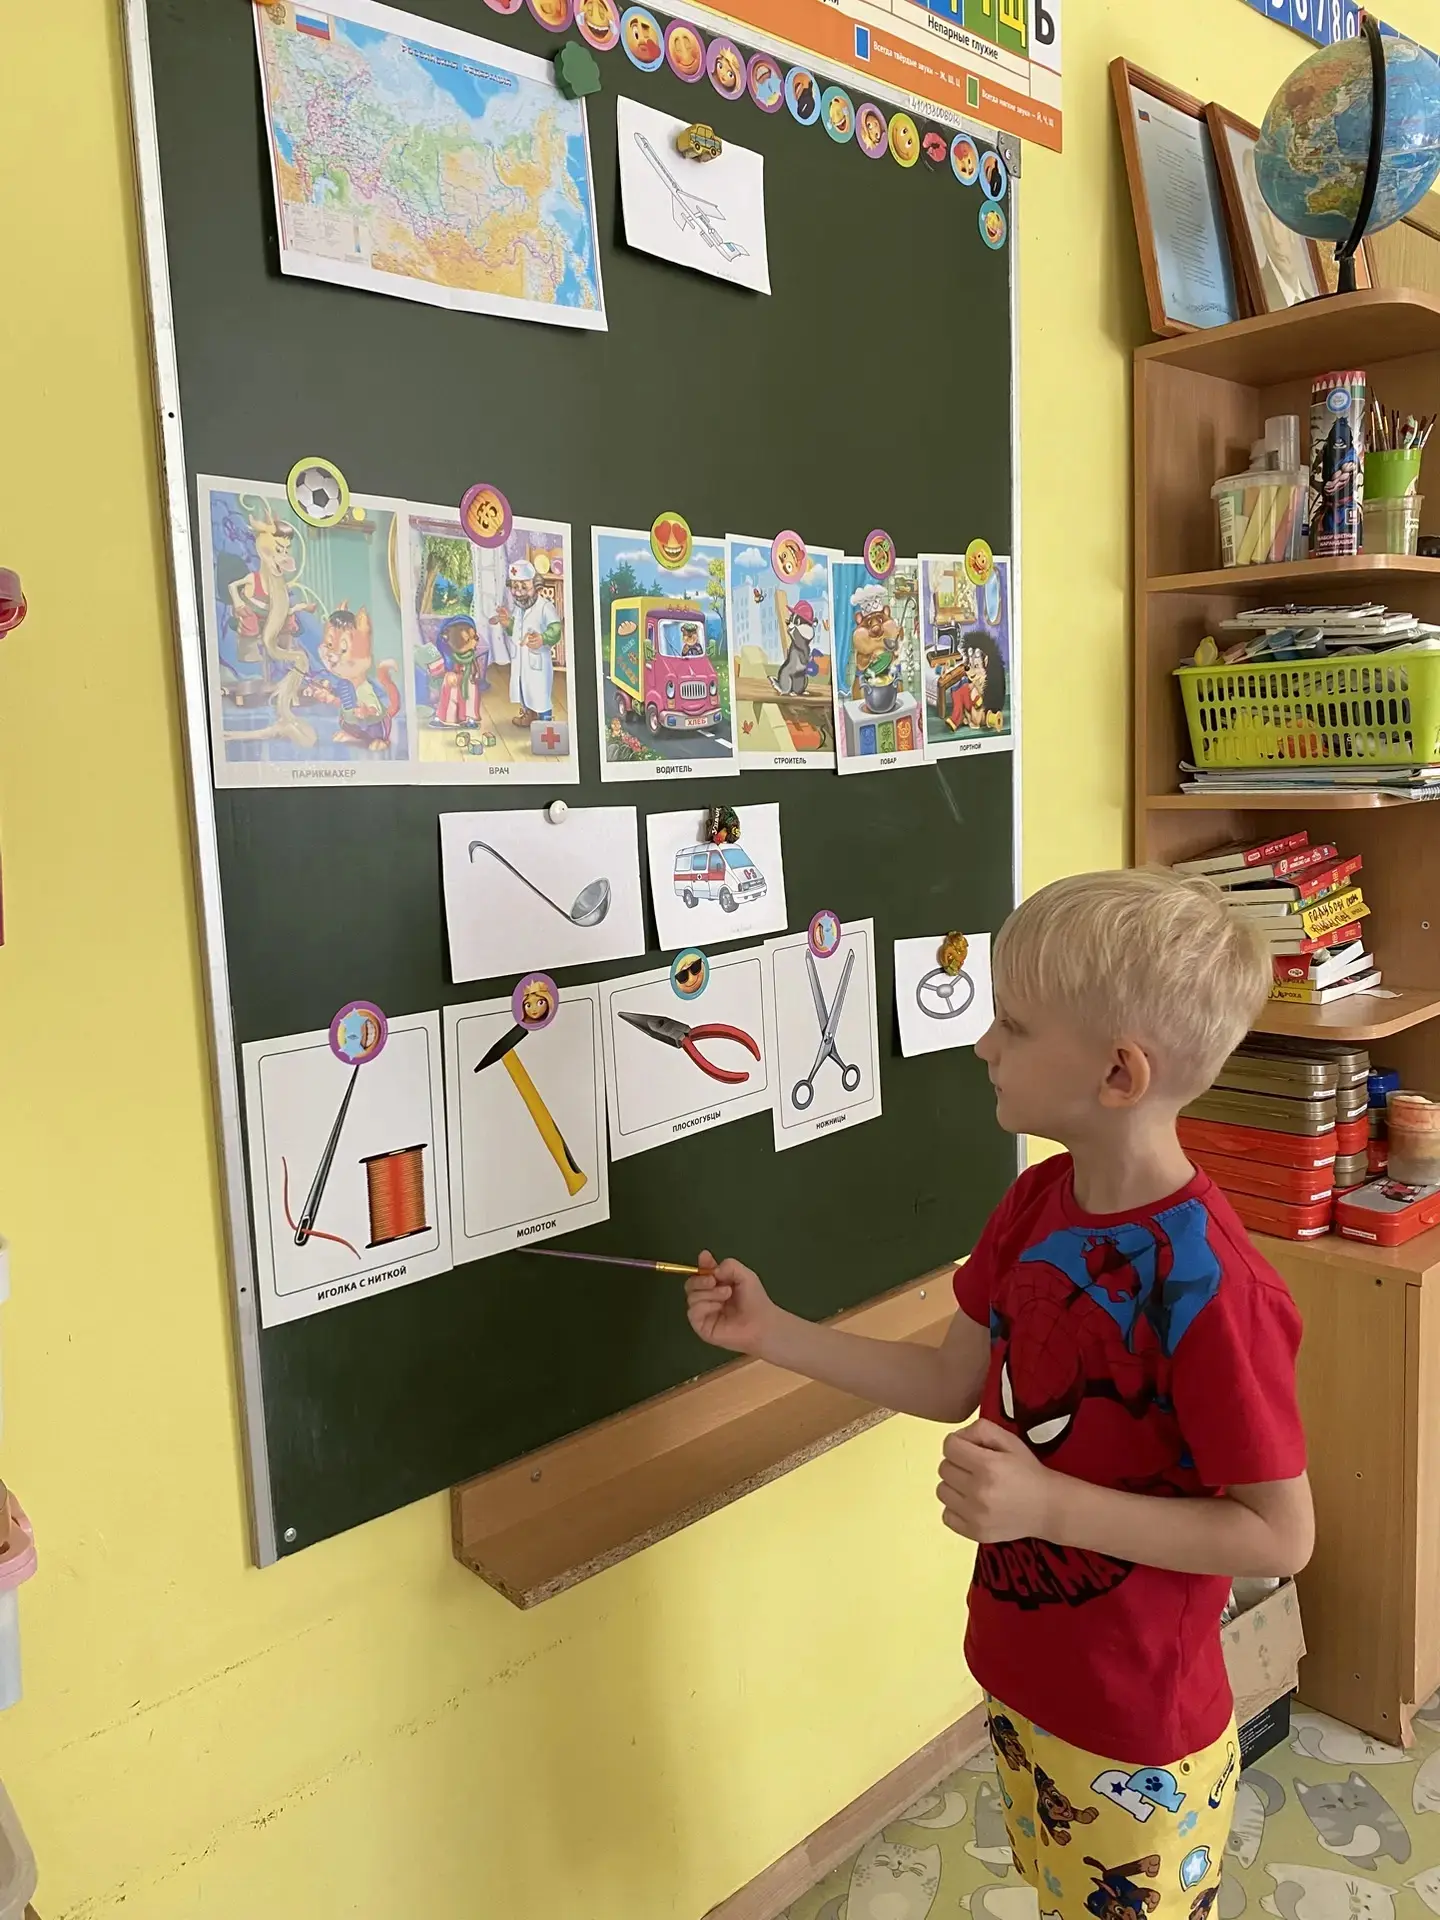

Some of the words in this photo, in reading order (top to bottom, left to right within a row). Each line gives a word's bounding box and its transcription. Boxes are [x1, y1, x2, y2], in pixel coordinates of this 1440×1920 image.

[928, 14, 970, 46] Непарные
[971, 37, 999, 60] глухие
[873, 40, 893, 57] Всегда
[893, 51, 918, 68] твёрдые
[688, 718, 706, 726] ХЛЕБ
[959, 743, 982, 752] ПОРТНОЙ
[774, 757, 807, 765] СТРОИТЕЛЬ
[880, 757, 897, 766] ПОВАР
[292, 768, 357, 779] ПАРИКМАХЕР
[489, 766, 509, 775] ВРАЧ
[656, 765, 693, 774] ВОДИТЕЛЬ
[672, 1110, 722, 1133] ПЛОСКОГУБЦЫ
[816, 1114, 847, 1130] НОЖНИЦЫ
[516, 1219, 557, 1238] МОЛОТОК
[317, 1282, 358, 1300] ИГОЛКА
[359, 1279, 366, 1288] С
[367, 1265, 408, 1286] НИТКОЙ
